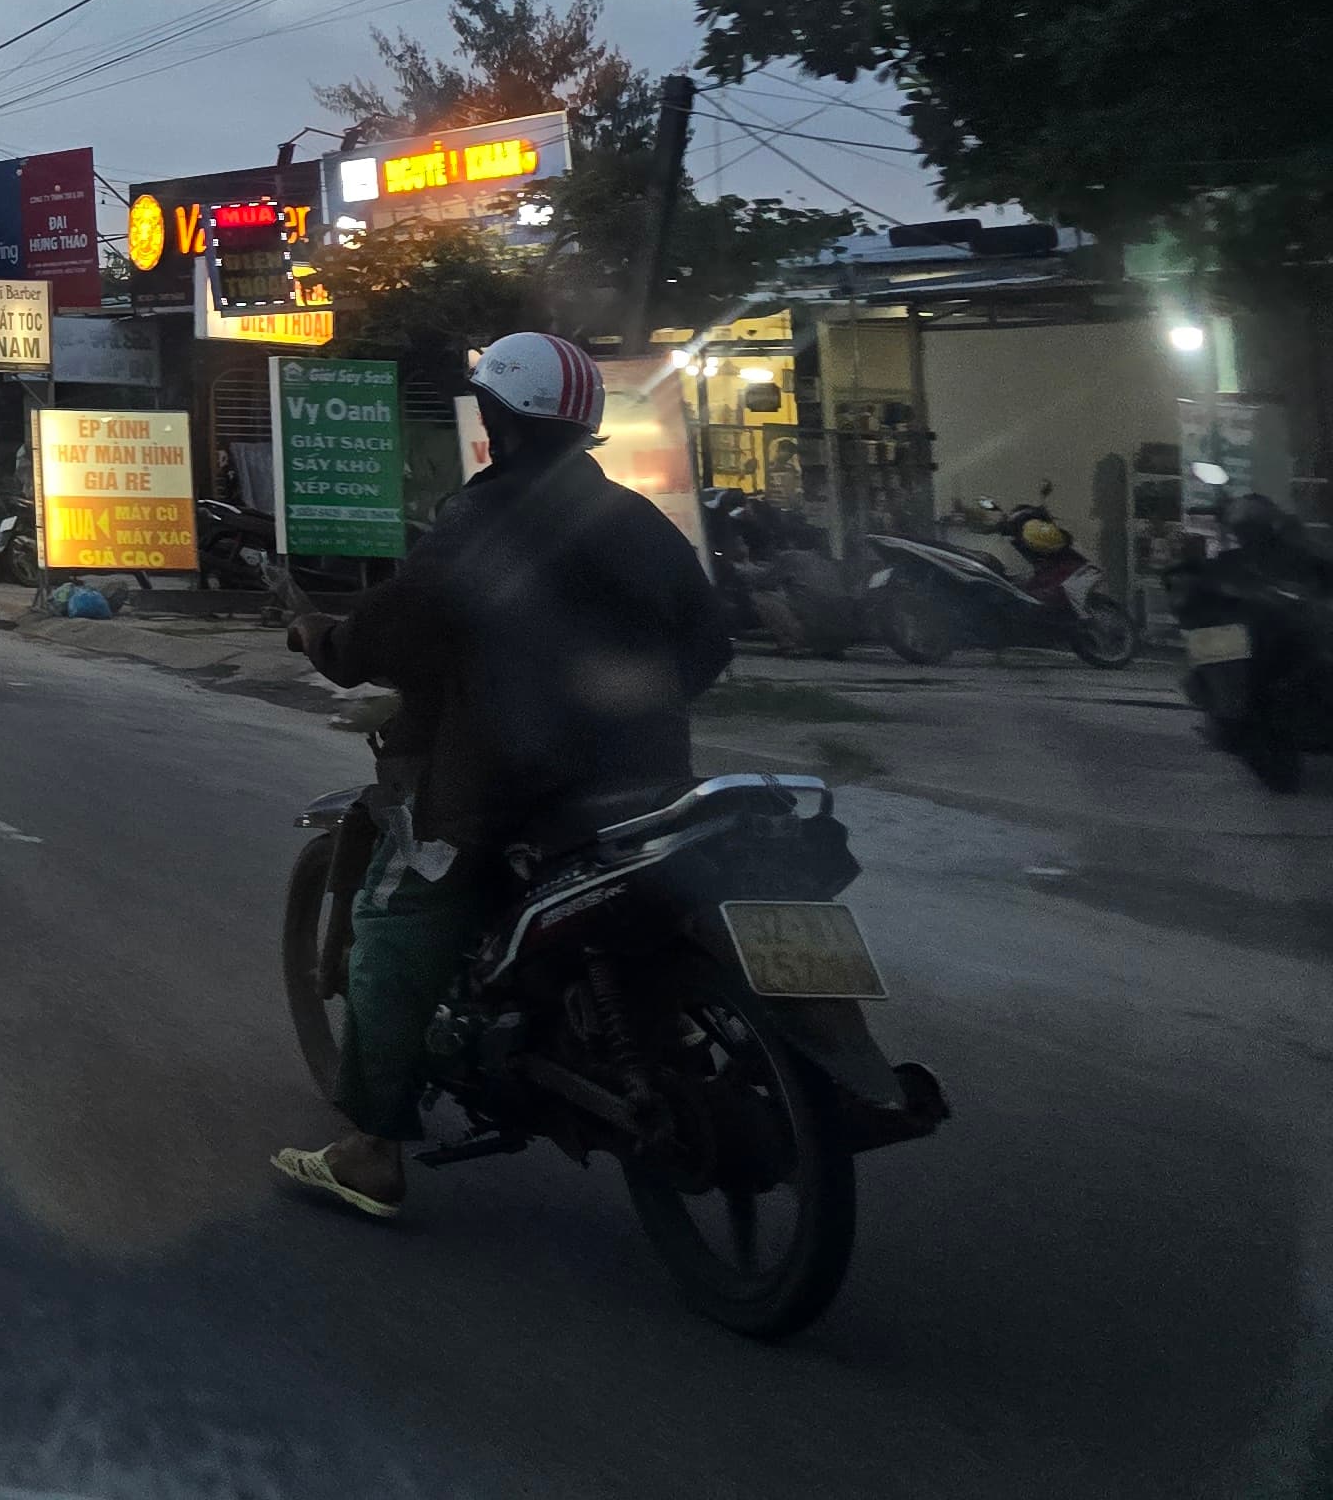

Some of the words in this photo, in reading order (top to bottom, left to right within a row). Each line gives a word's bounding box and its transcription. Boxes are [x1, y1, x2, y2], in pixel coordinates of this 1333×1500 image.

[48, 215, 68, 233] ĐẠI
[221, 208, 275, 224] MUA
[6, 285, 42, 301] Barber
[18, 308, 43, 331] TÓC
[325, 397, 391, 422] Oanh
[78, 415, 101, 438] ÉP
[106, 416, 151, 439] KÍNH
[52, 443, 92, 464] HAY
[94, 441, 136, 465] MÀN
[141, 442, 184, 466] HÌNH
[340, 436, 393, 453] SẠCH
[84, 467, 119, 491] GIÁ
[114, 504, 151, 521] MÁY
[116, 527, 155, 545] MÁY
[121, 551, 165, 567] CAO
